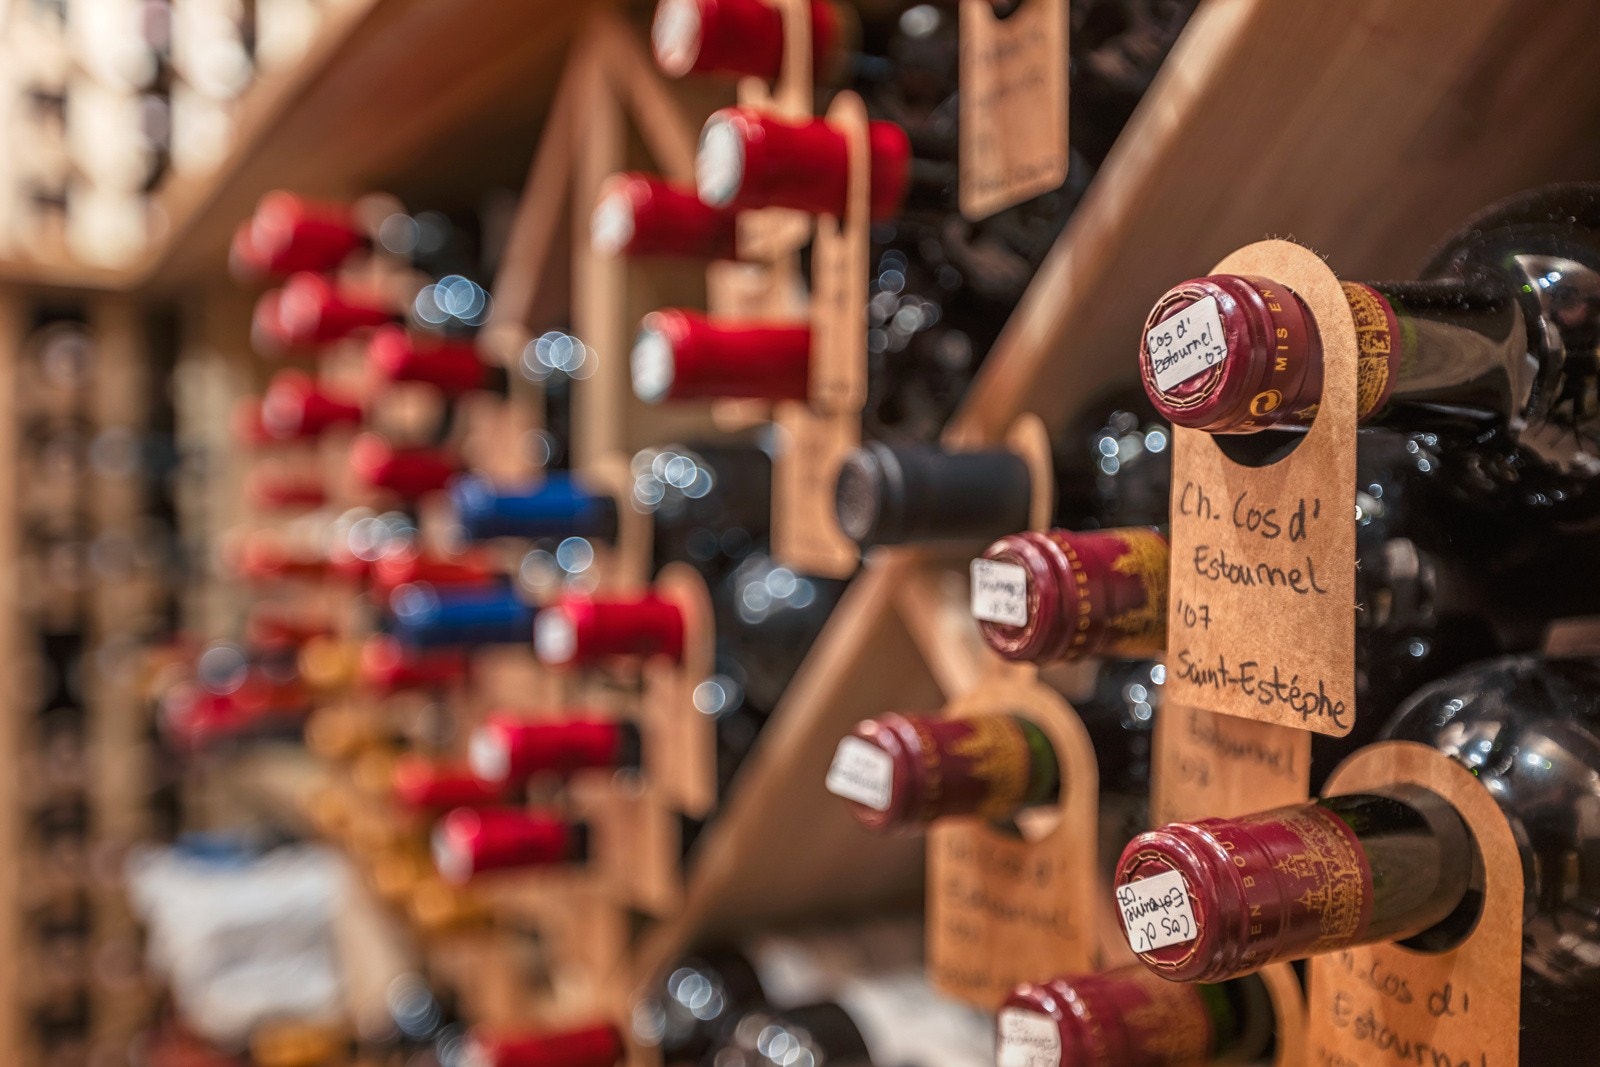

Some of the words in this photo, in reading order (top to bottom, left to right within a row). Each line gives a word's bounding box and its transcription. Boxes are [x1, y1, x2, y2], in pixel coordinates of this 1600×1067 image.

[1261, 288, 1282, 312] EN
[1149, 331, 1173, 355] Cos
[1274, 327, 1289, 371] MIS
[1180, 481, 1220, 520] Ch.
[1232, 490, 1282, 539] Cos
[1289, 498, 1321, 542] d'
[1193, 545, 1327, 595] Estournel
[1177, 600, 1212, 630] '07
[1161, 914, 1190, 938] Cos
[1250, 904, 1262, 936] EN
